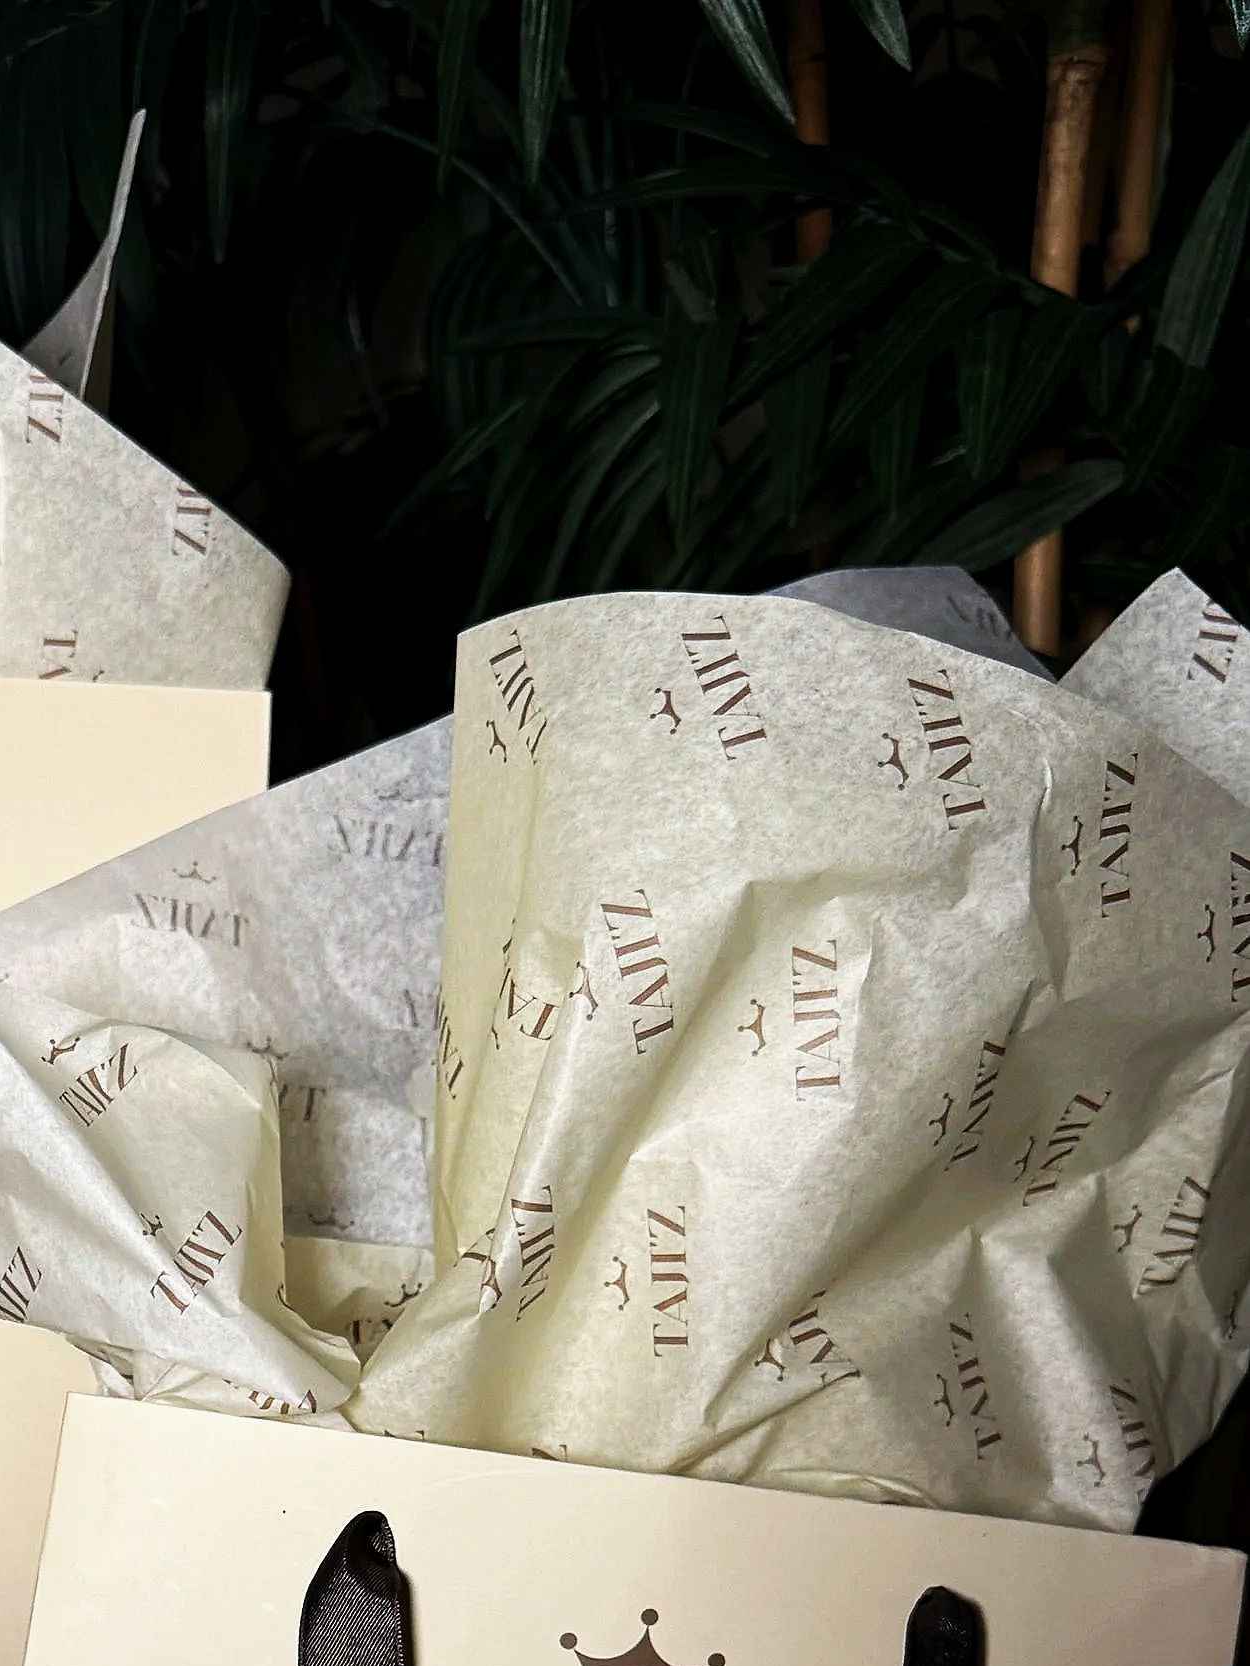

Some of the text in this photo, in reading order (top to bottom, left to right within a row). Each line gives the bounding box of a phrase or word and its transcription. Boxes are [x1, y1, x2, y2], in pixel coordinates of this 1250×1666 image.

[681, 614, 767, 761] TAJI'Z
[907, 669, 986, 831] TAJI'Z
[1099, 753, 1138, 918] TAJI'Z
[600, 889, 674, 1055] TAJI'Z
[791, 939, 843, 1102] TAJI'Z
[647, 1205, 689, 1357] TAJI'Z
